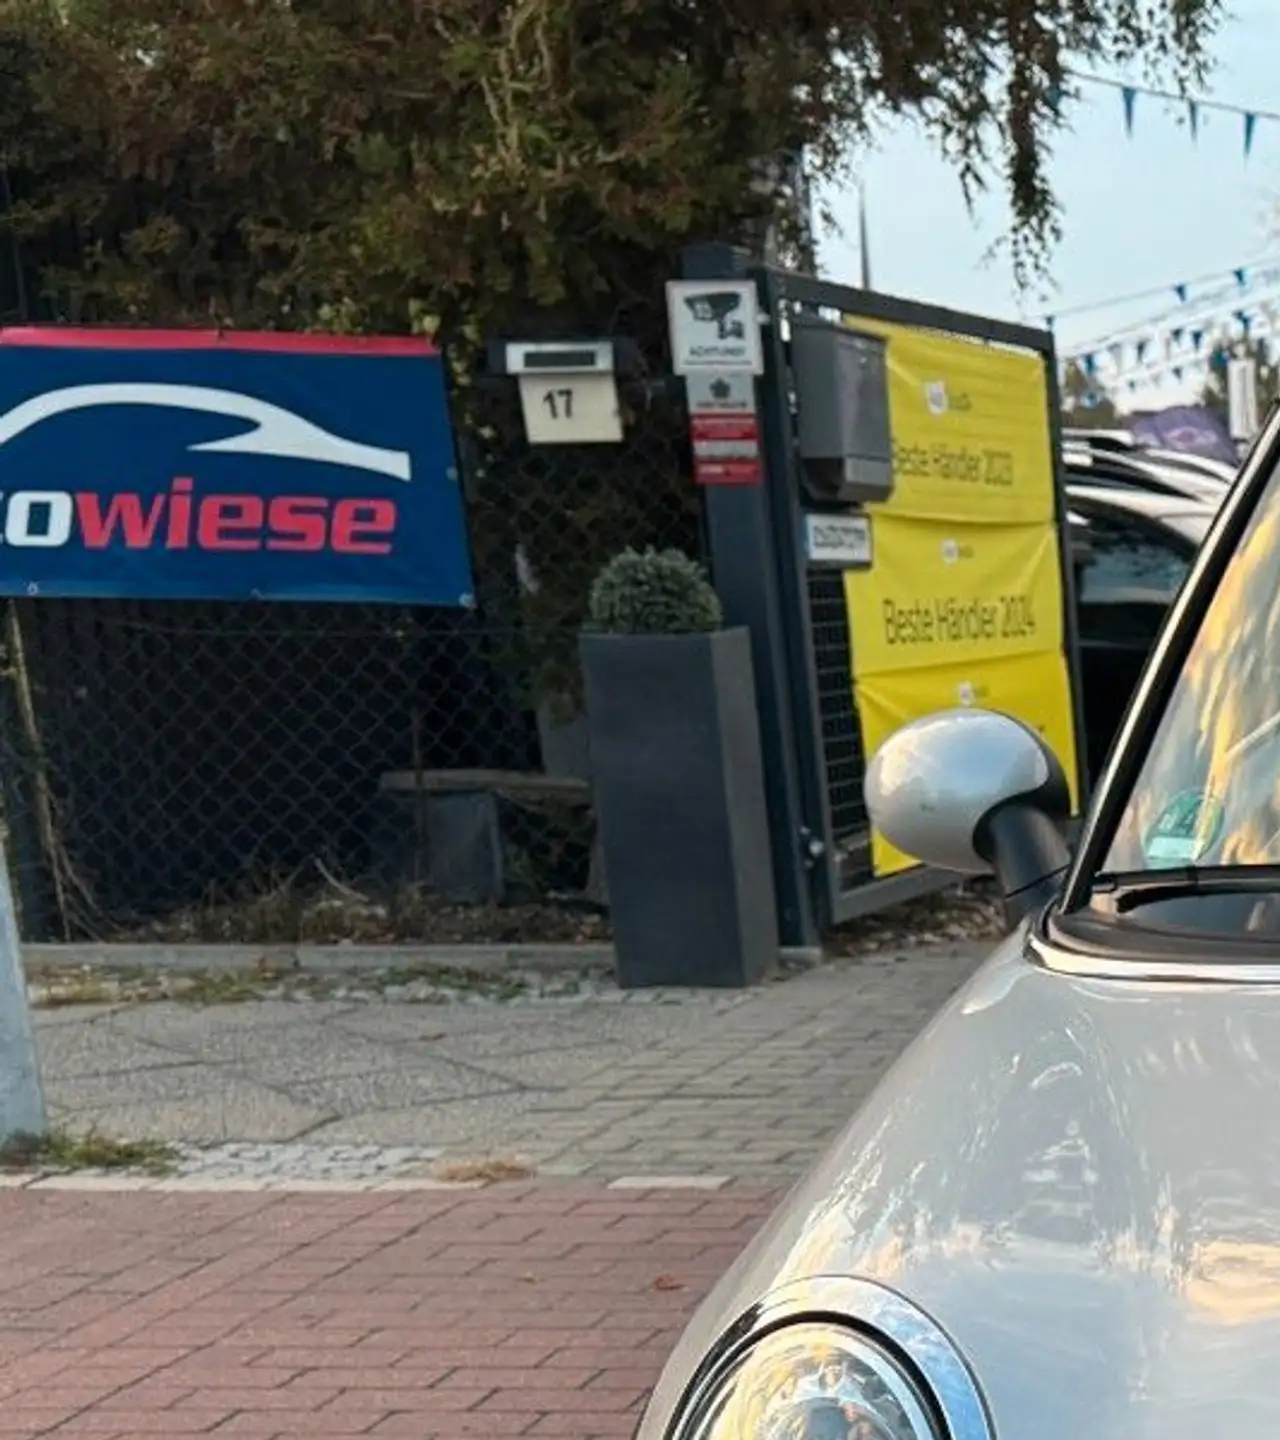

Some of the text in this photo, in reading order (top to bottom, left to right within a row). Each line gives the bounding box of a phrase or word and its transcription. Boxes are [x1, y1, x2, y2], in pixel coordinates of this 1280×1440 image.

[543, 388, 574, 419] 17
[0, 477, 398, 554] owiese
[883, 596, 934, 645] Beste
[935, 594, 997, 641] Händler
